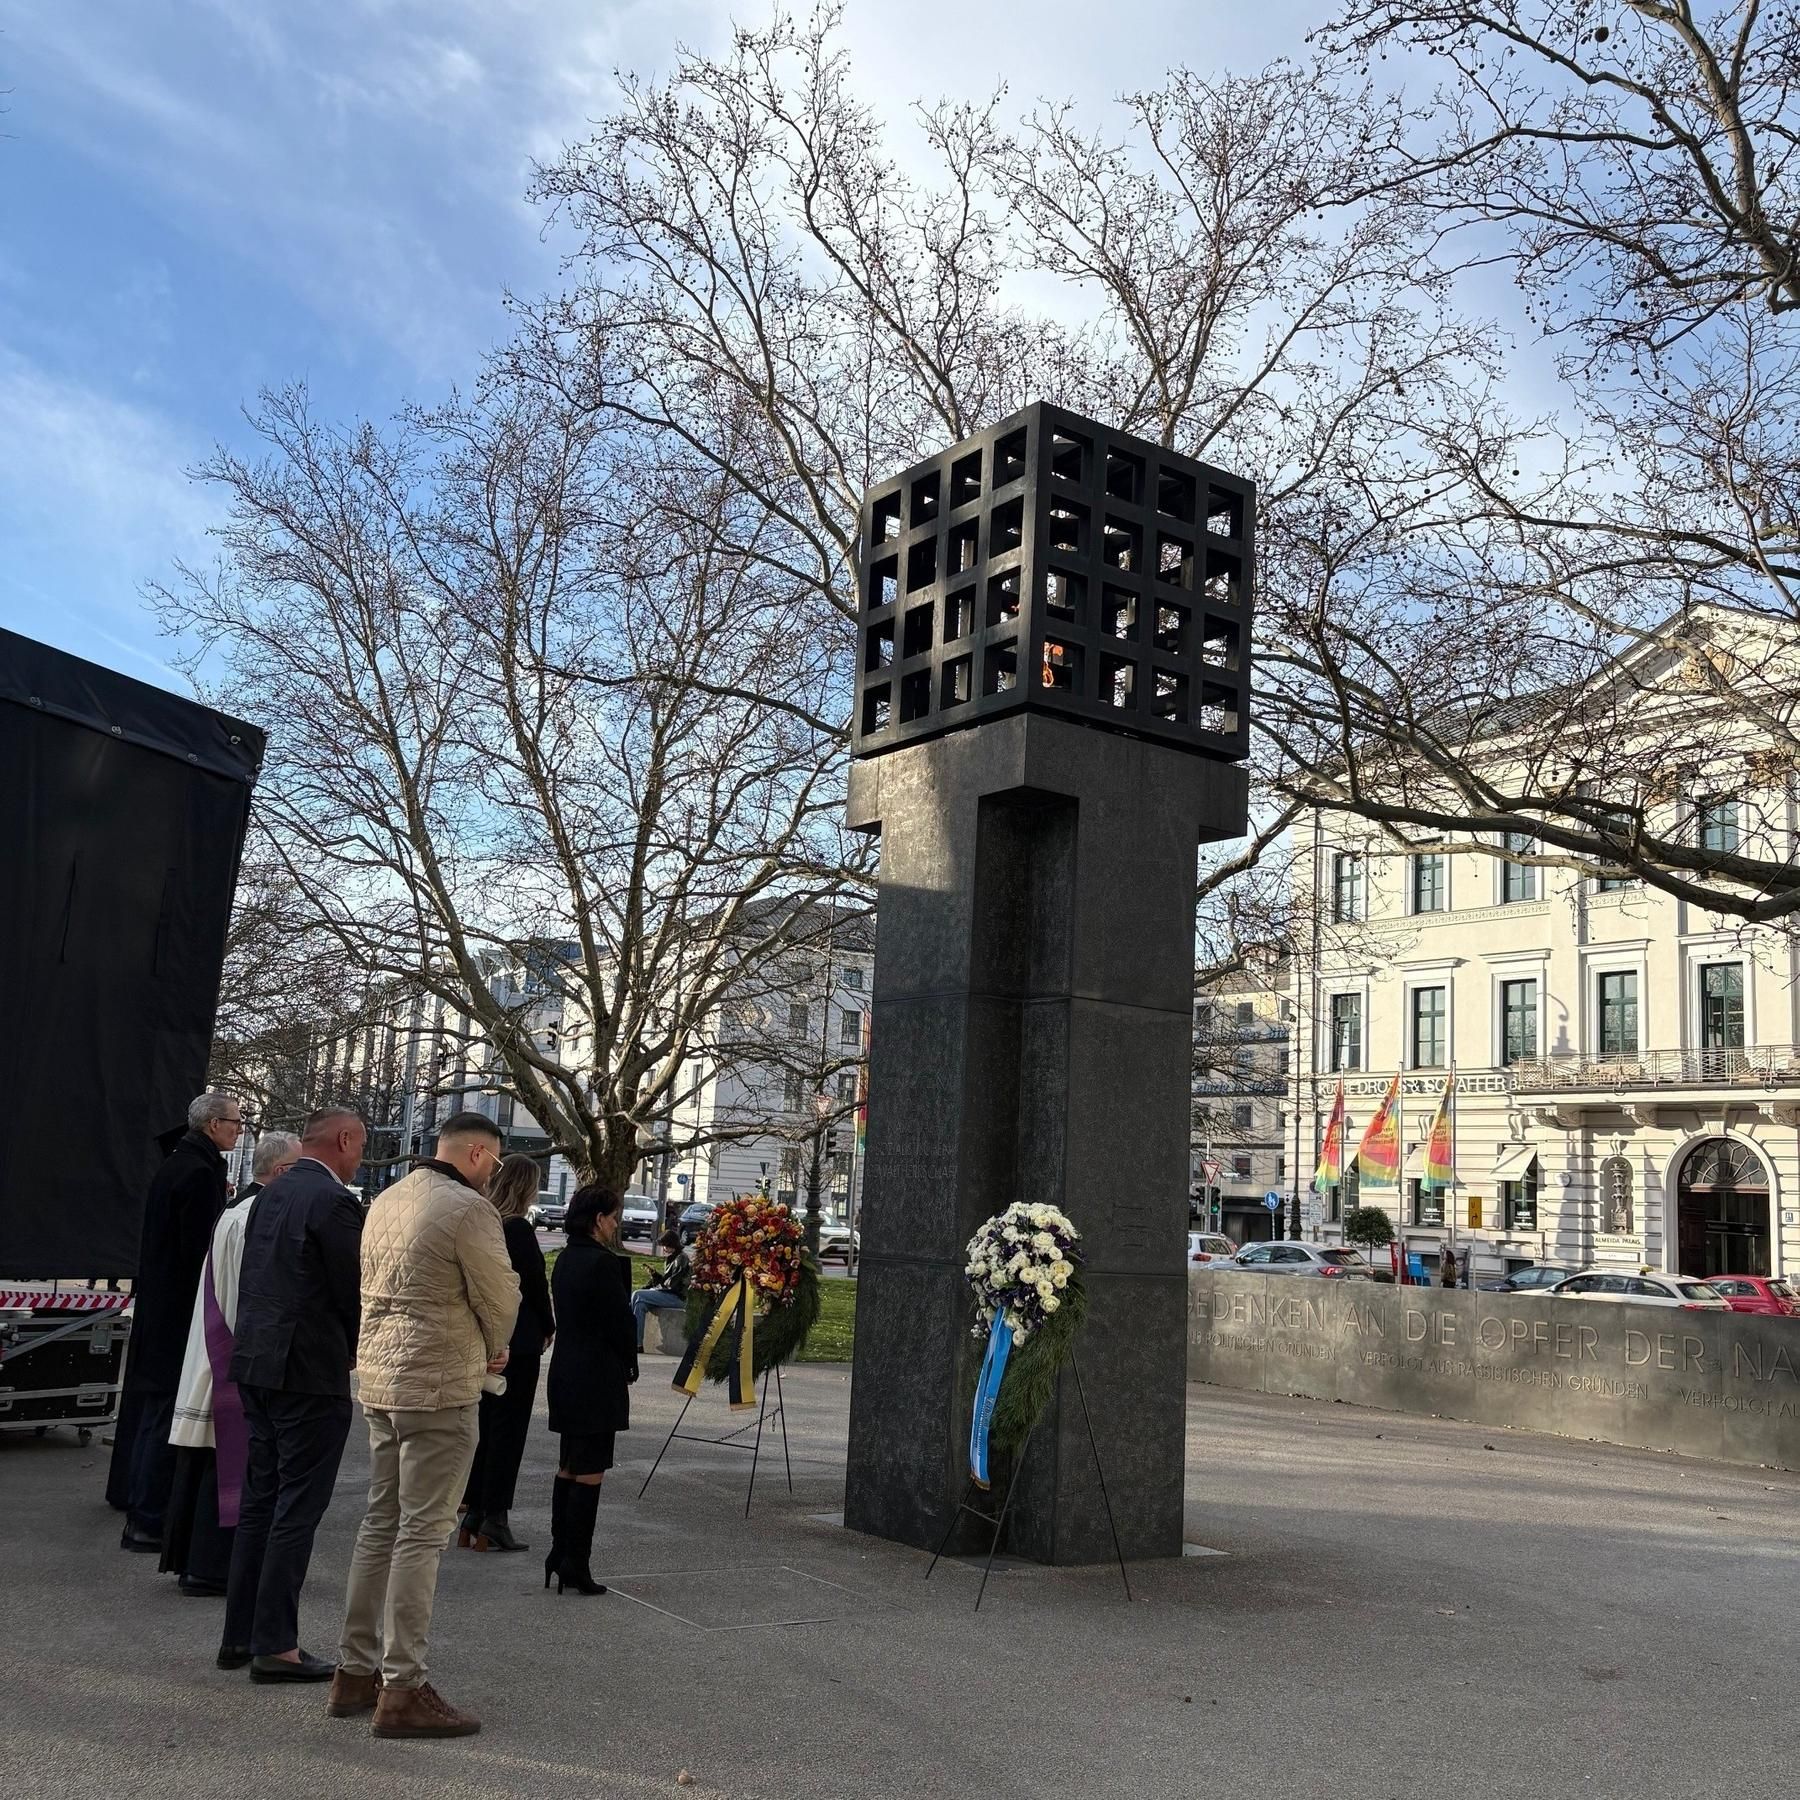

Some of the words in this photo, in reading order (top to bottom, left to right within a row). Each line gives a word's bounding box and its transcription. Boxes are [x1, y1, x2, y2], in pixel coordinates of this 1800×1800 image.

[1425, 1076, 1506, 1092] SCAFFER
[1206, 1330, 1274, 1353] POLITISCHEN
[1359, 1351, 1424, 1372] VERFOLGT
[1429, 1359, 1453, 1376] AUS
[1457, 1361, 1563, 1389] RASSISTISCHEN
[1568, 1374, 1648, 1400] GRÜNDEN
[1679, 1388, 1773, 1416] VERFOLGT
[1342, 1302, 1386, 1337] AN
[1406, 1308, 1456, 1345] DIE
[1479, 1316, 1600, 1361] OPFER
[1625, 1329, 1705, 1374] DER
[1734, 1341, 1800, 1384] NA
